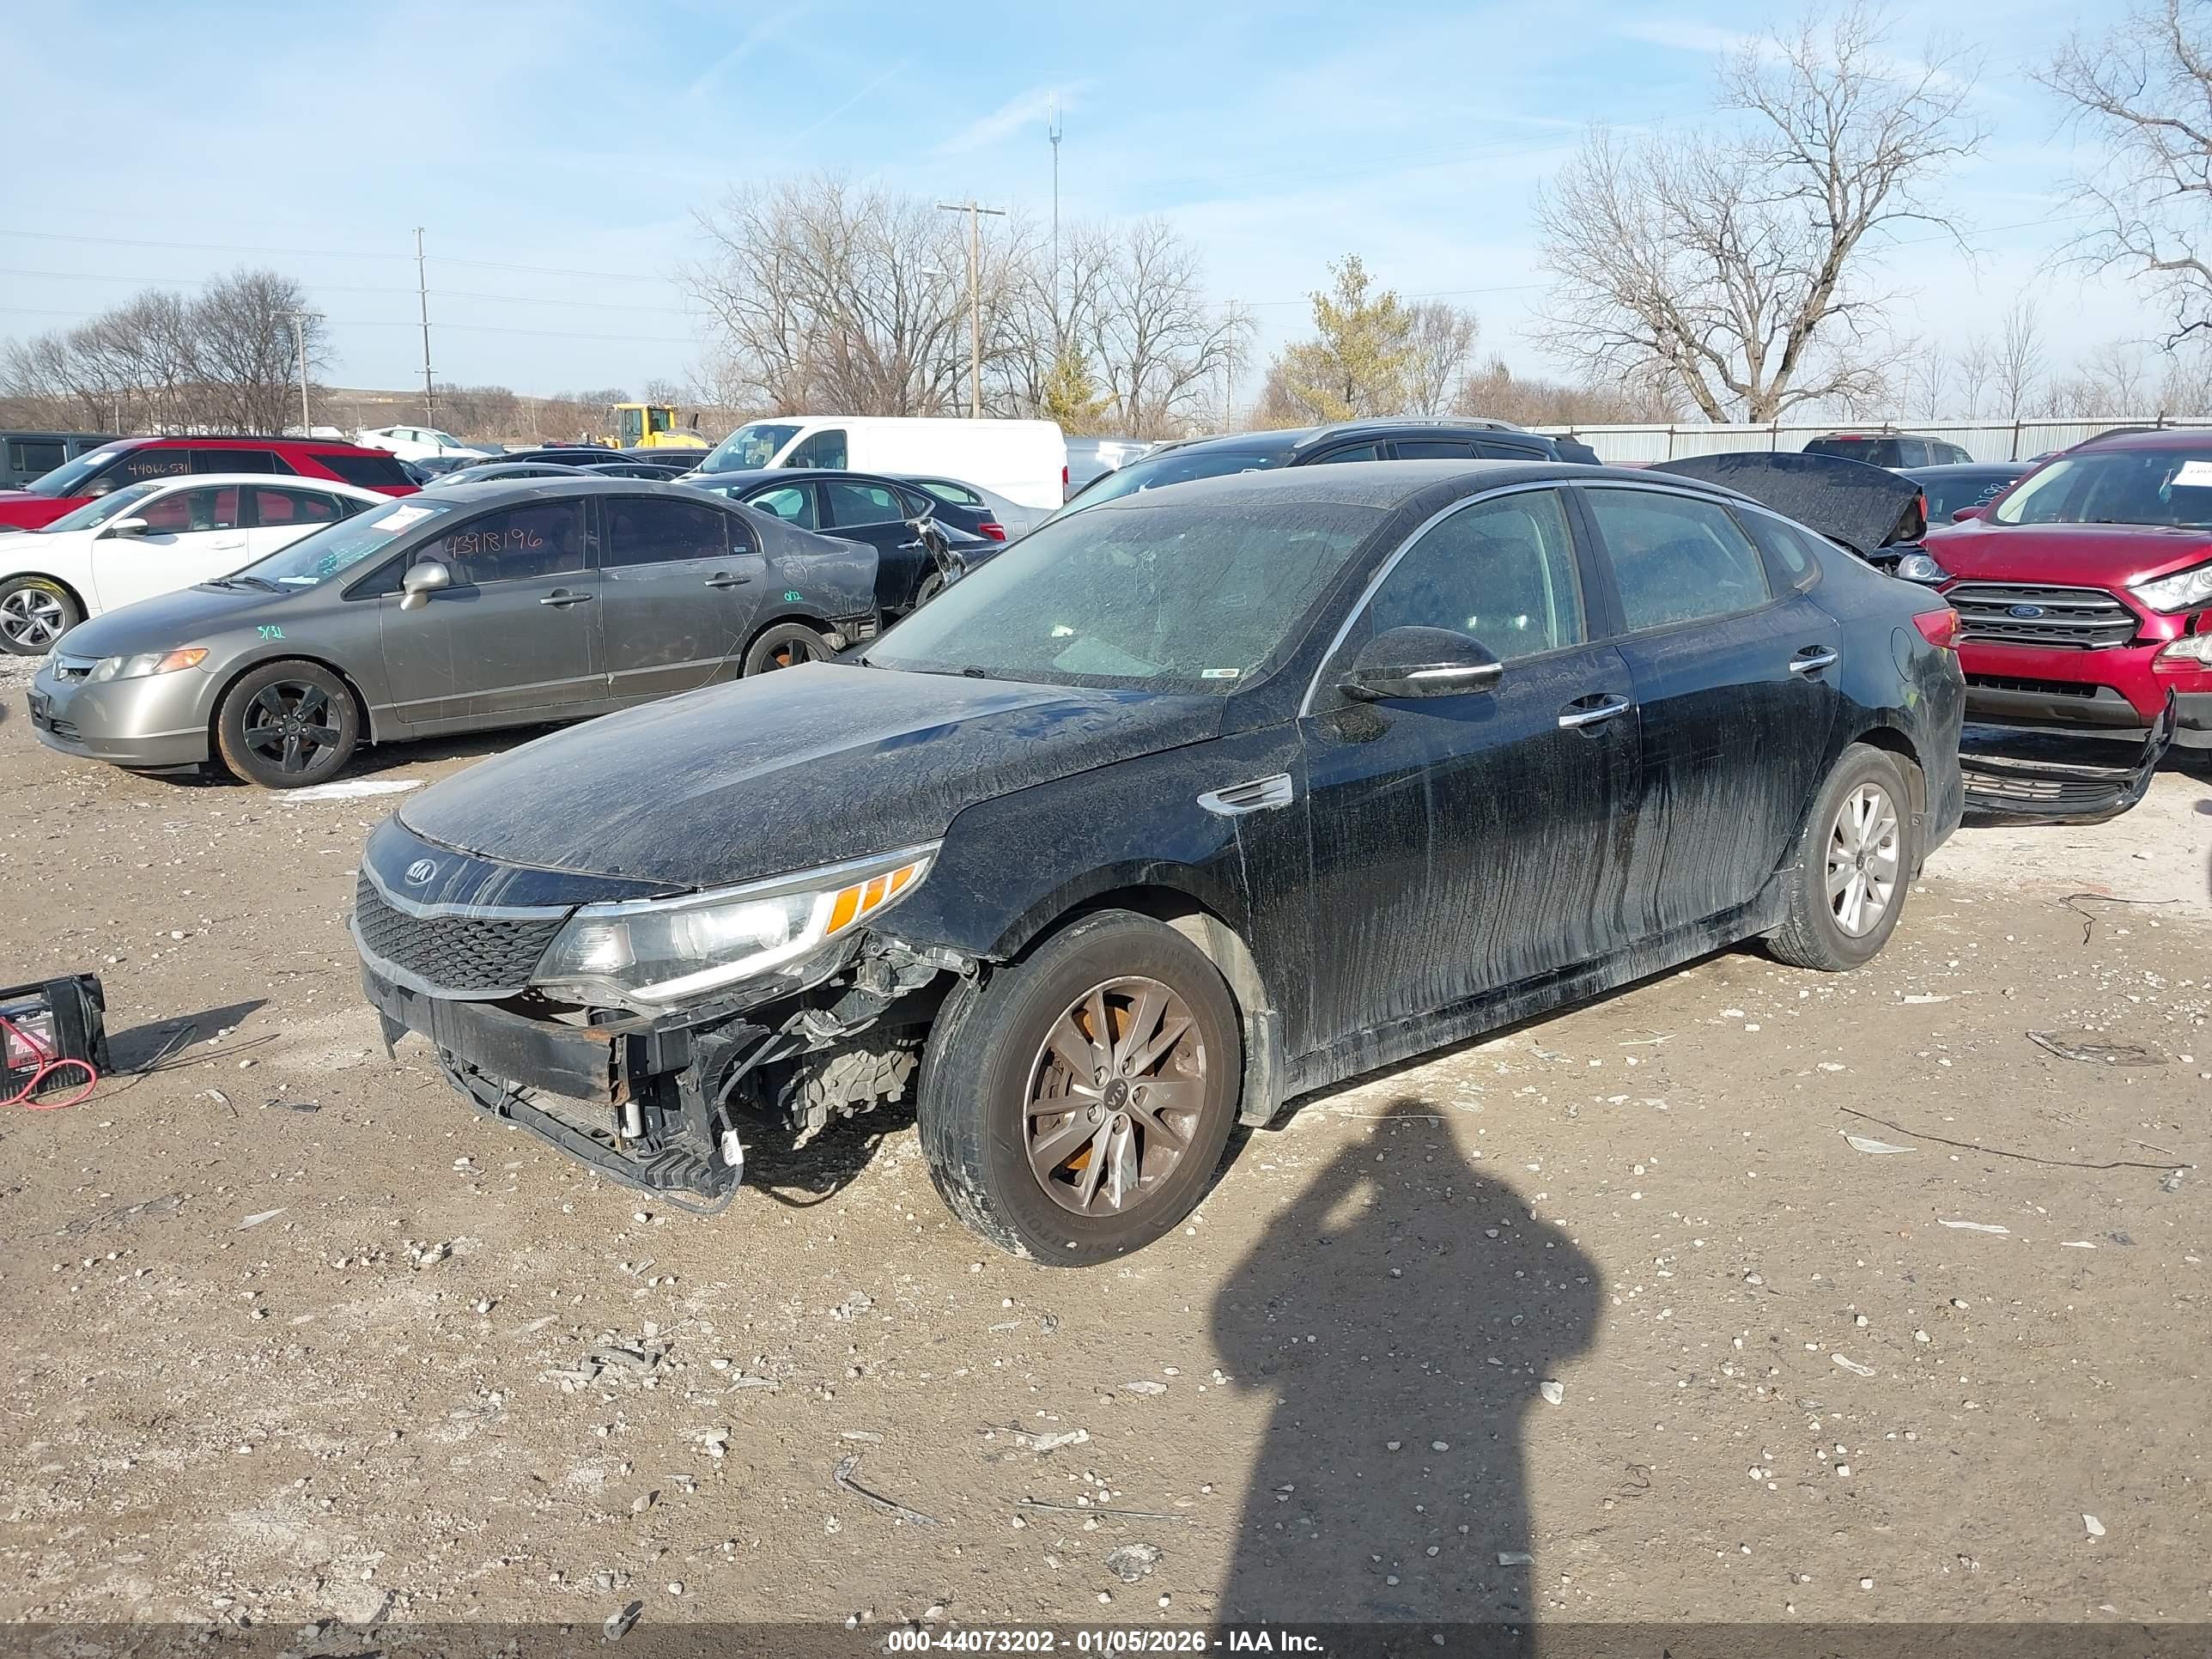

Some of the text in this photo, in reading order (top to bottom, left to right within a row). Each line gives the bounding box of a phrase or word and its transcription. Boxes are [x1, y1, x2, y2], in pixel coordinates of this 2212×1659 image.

[445, 528, 543, 559] 43918196
[406, 861, 431, 881] KIA
[1108, 1082, 1126, 1107] KIA
